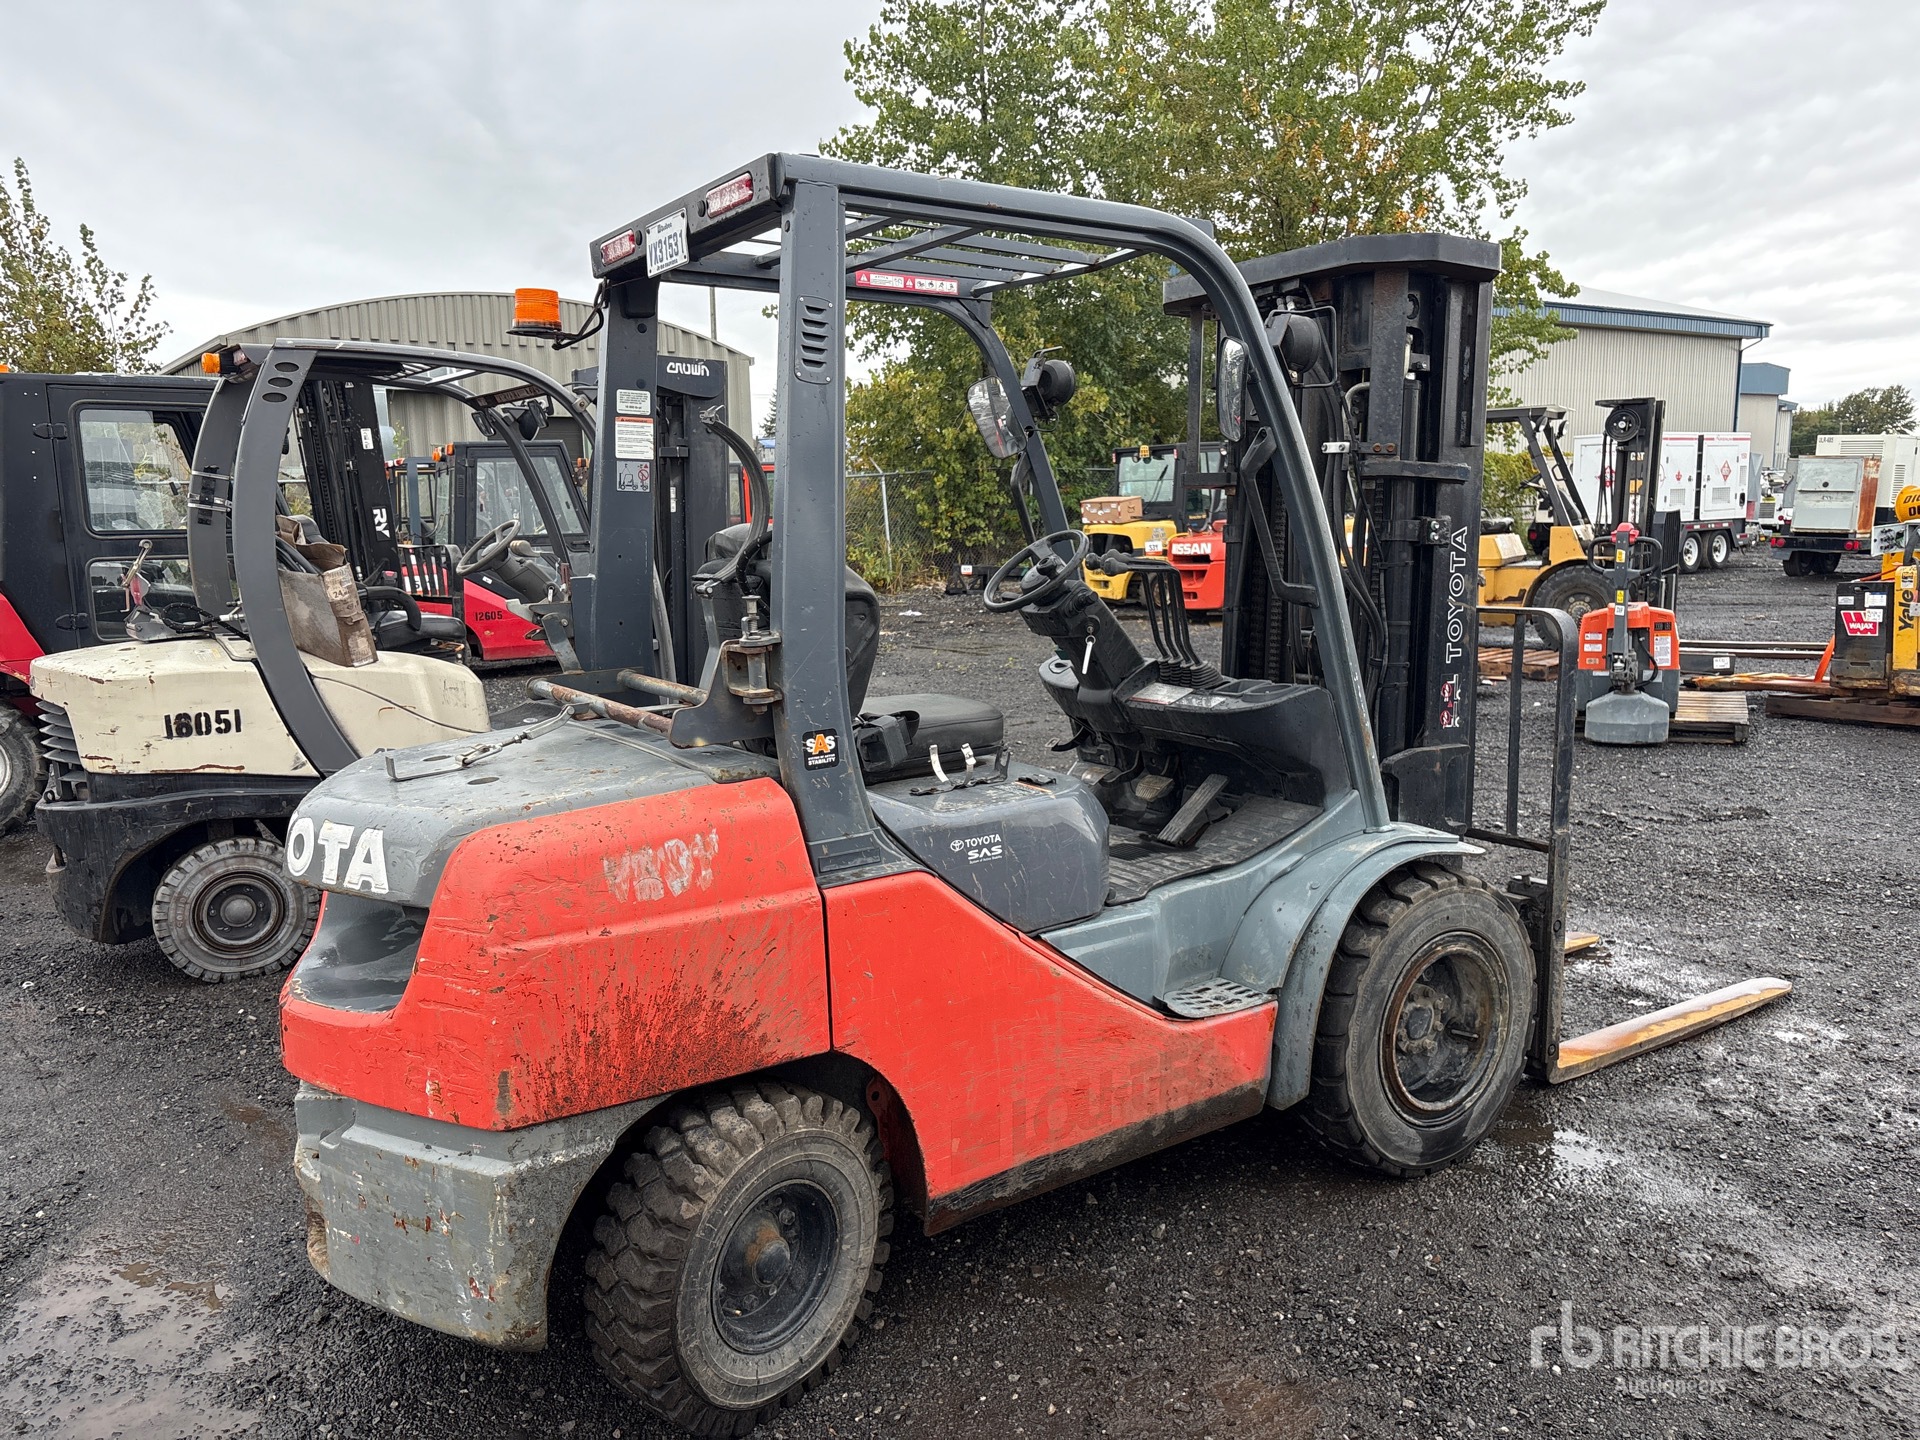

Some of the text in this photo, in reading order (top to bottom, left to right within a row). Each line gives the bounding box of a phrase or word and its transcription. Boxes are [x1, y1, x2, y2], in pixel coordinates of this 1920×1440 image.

[1446, 526, 1468, 664] TOYOTA
[475, 610, 503, 621] 12605
[1898, 589, 1914, 631] Yale
[1849, 622, 1874, 631] WAJAX
[164, 708, 242, 740] 18051
[806, 733, 836, 755] SAS
[808, 757, 836, 766] STABILITY
[965, 833, 1002, 848] TOYOTA
[285, 810, 389, 894] OTA
[967, 845, 1003, 860] SAS
